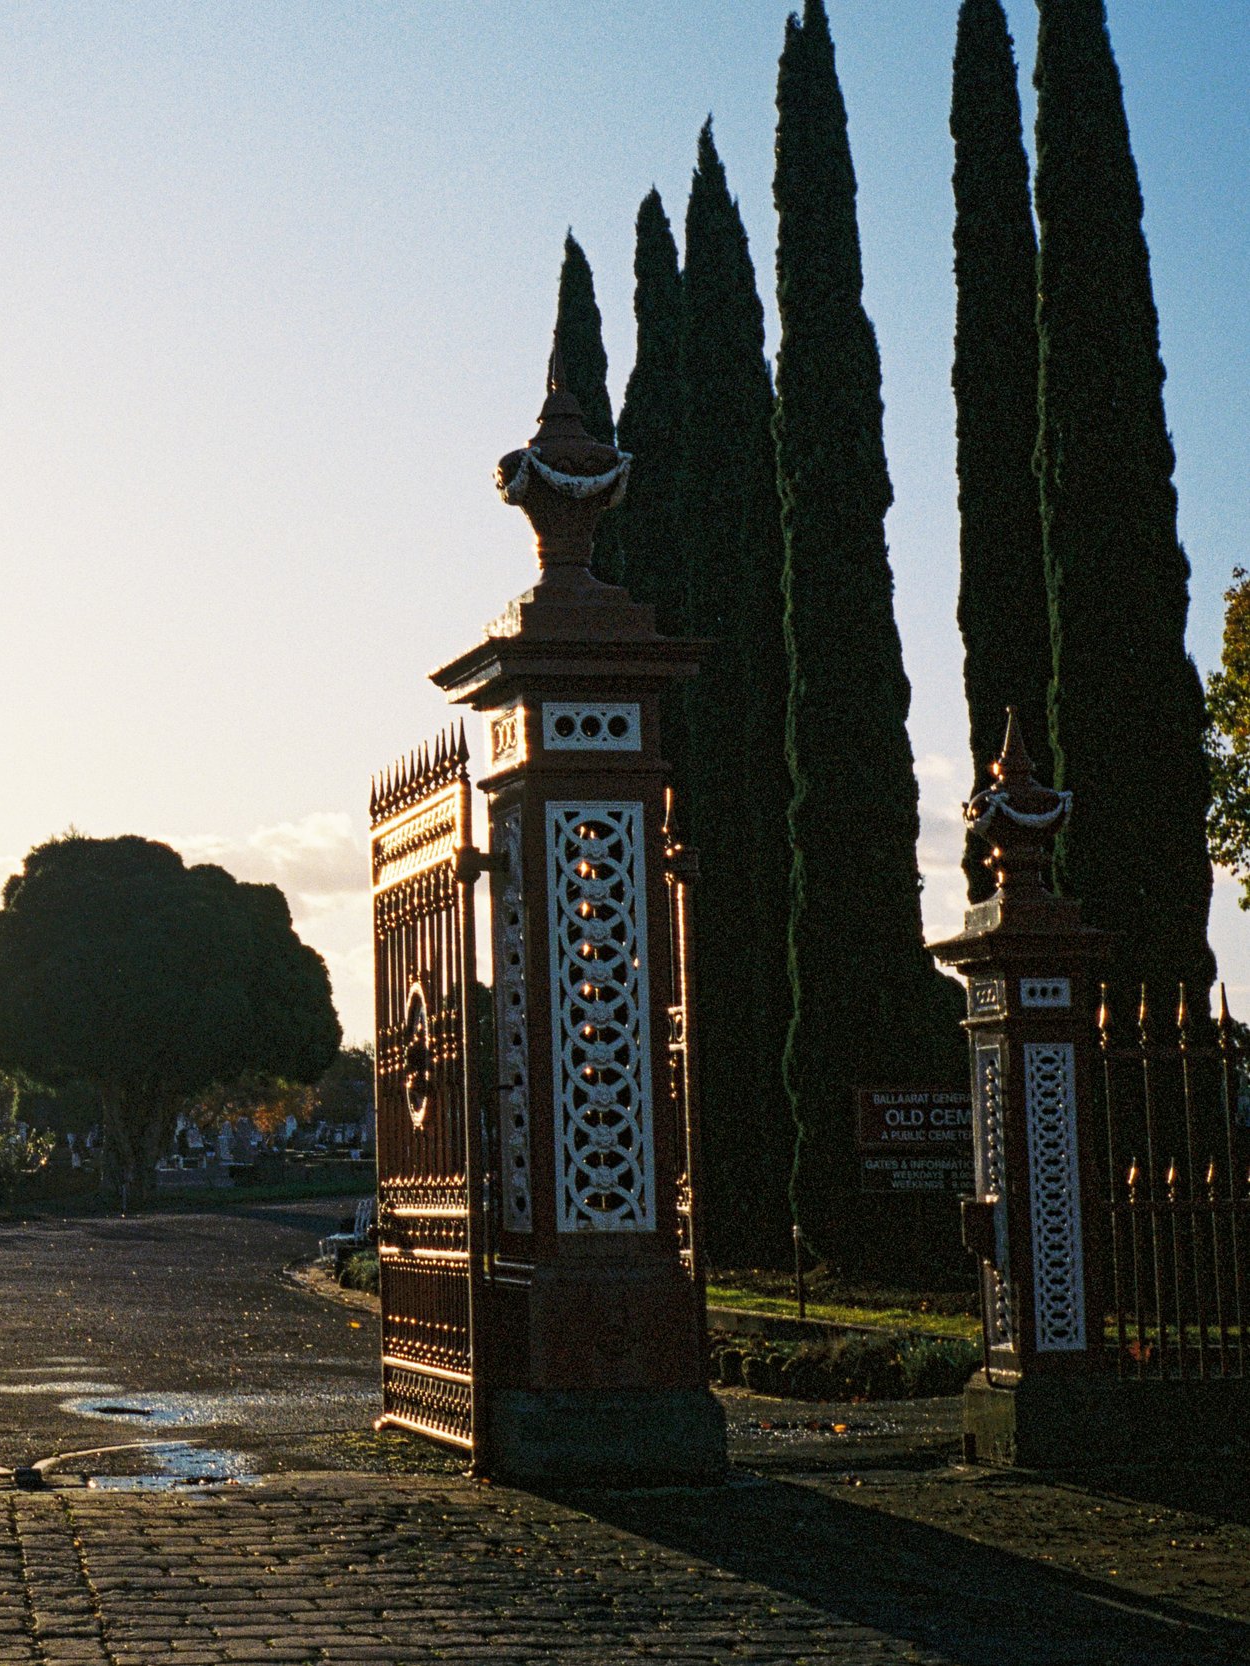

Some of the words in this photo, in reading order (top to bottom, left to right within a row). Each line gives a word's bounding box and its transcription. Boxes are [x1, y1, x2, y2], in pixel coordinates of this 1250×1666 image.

[873, 1093, 929, 1104] BALLAARAT
[885, 1109, 924, 1126] OLD
[881, 1130, 889, 1140] A
[891, 1130, 926, 1140] PUBLIC
[865, 1159, 899, 1169] GATES
[900, 1159, 908, 1169] &
[893, 1170, 944, 1179] WEEKDAYS
